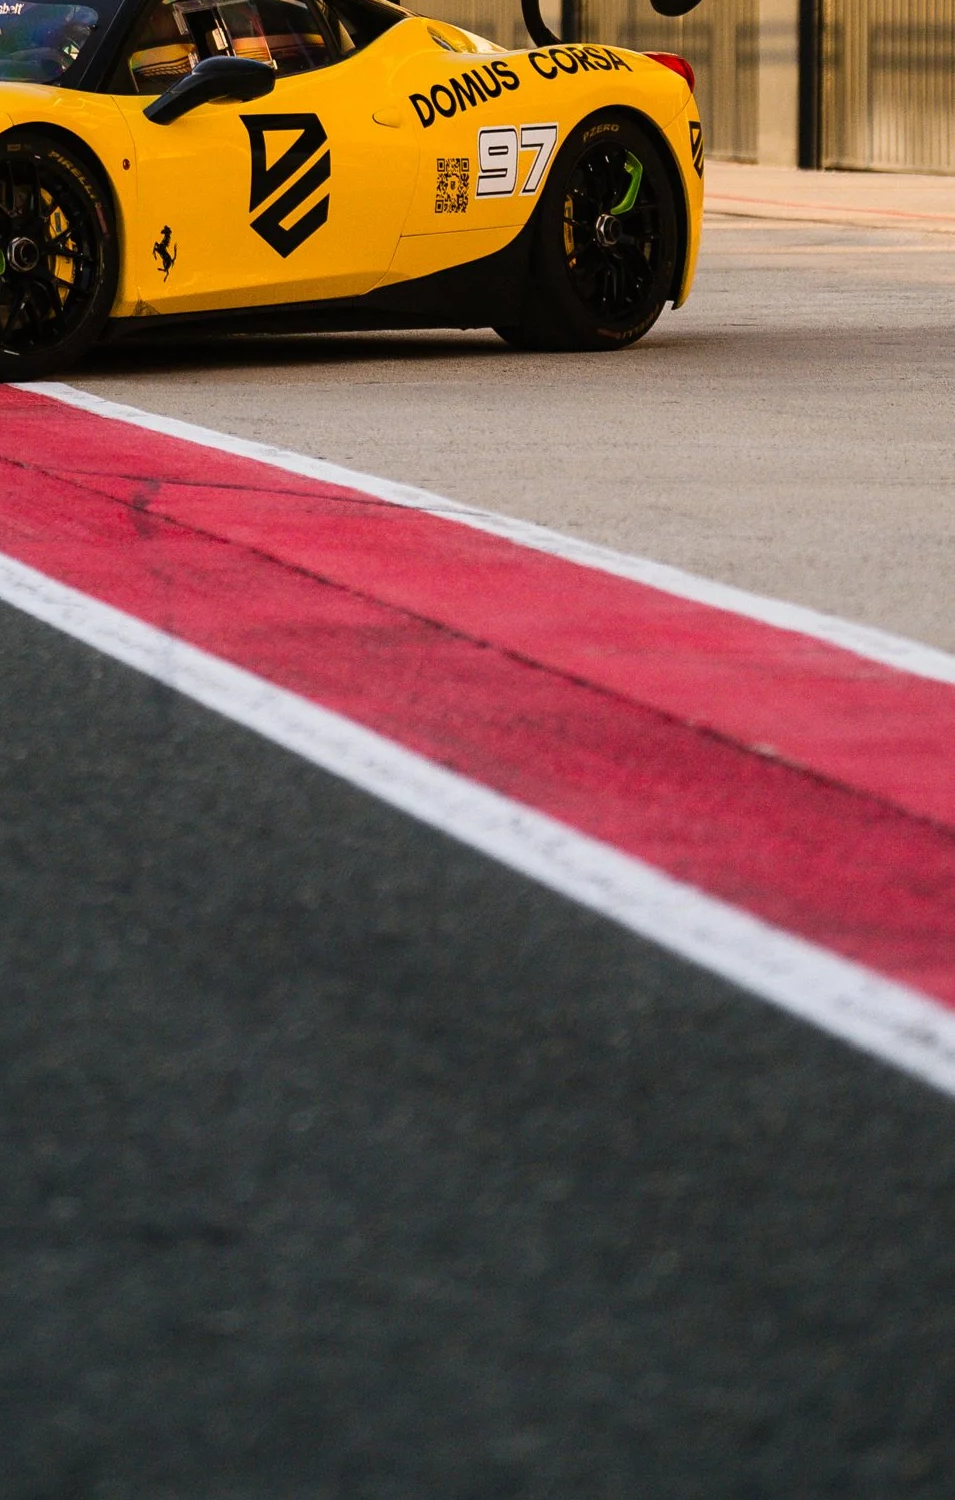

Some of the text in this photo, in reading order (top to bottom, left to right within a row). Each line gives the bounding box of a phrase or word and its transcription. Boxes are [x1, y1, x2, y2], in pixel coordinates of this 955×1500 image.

[408, 47, 633, 128] DOMUS CORSA
[475, 122, 558, 199] 97
